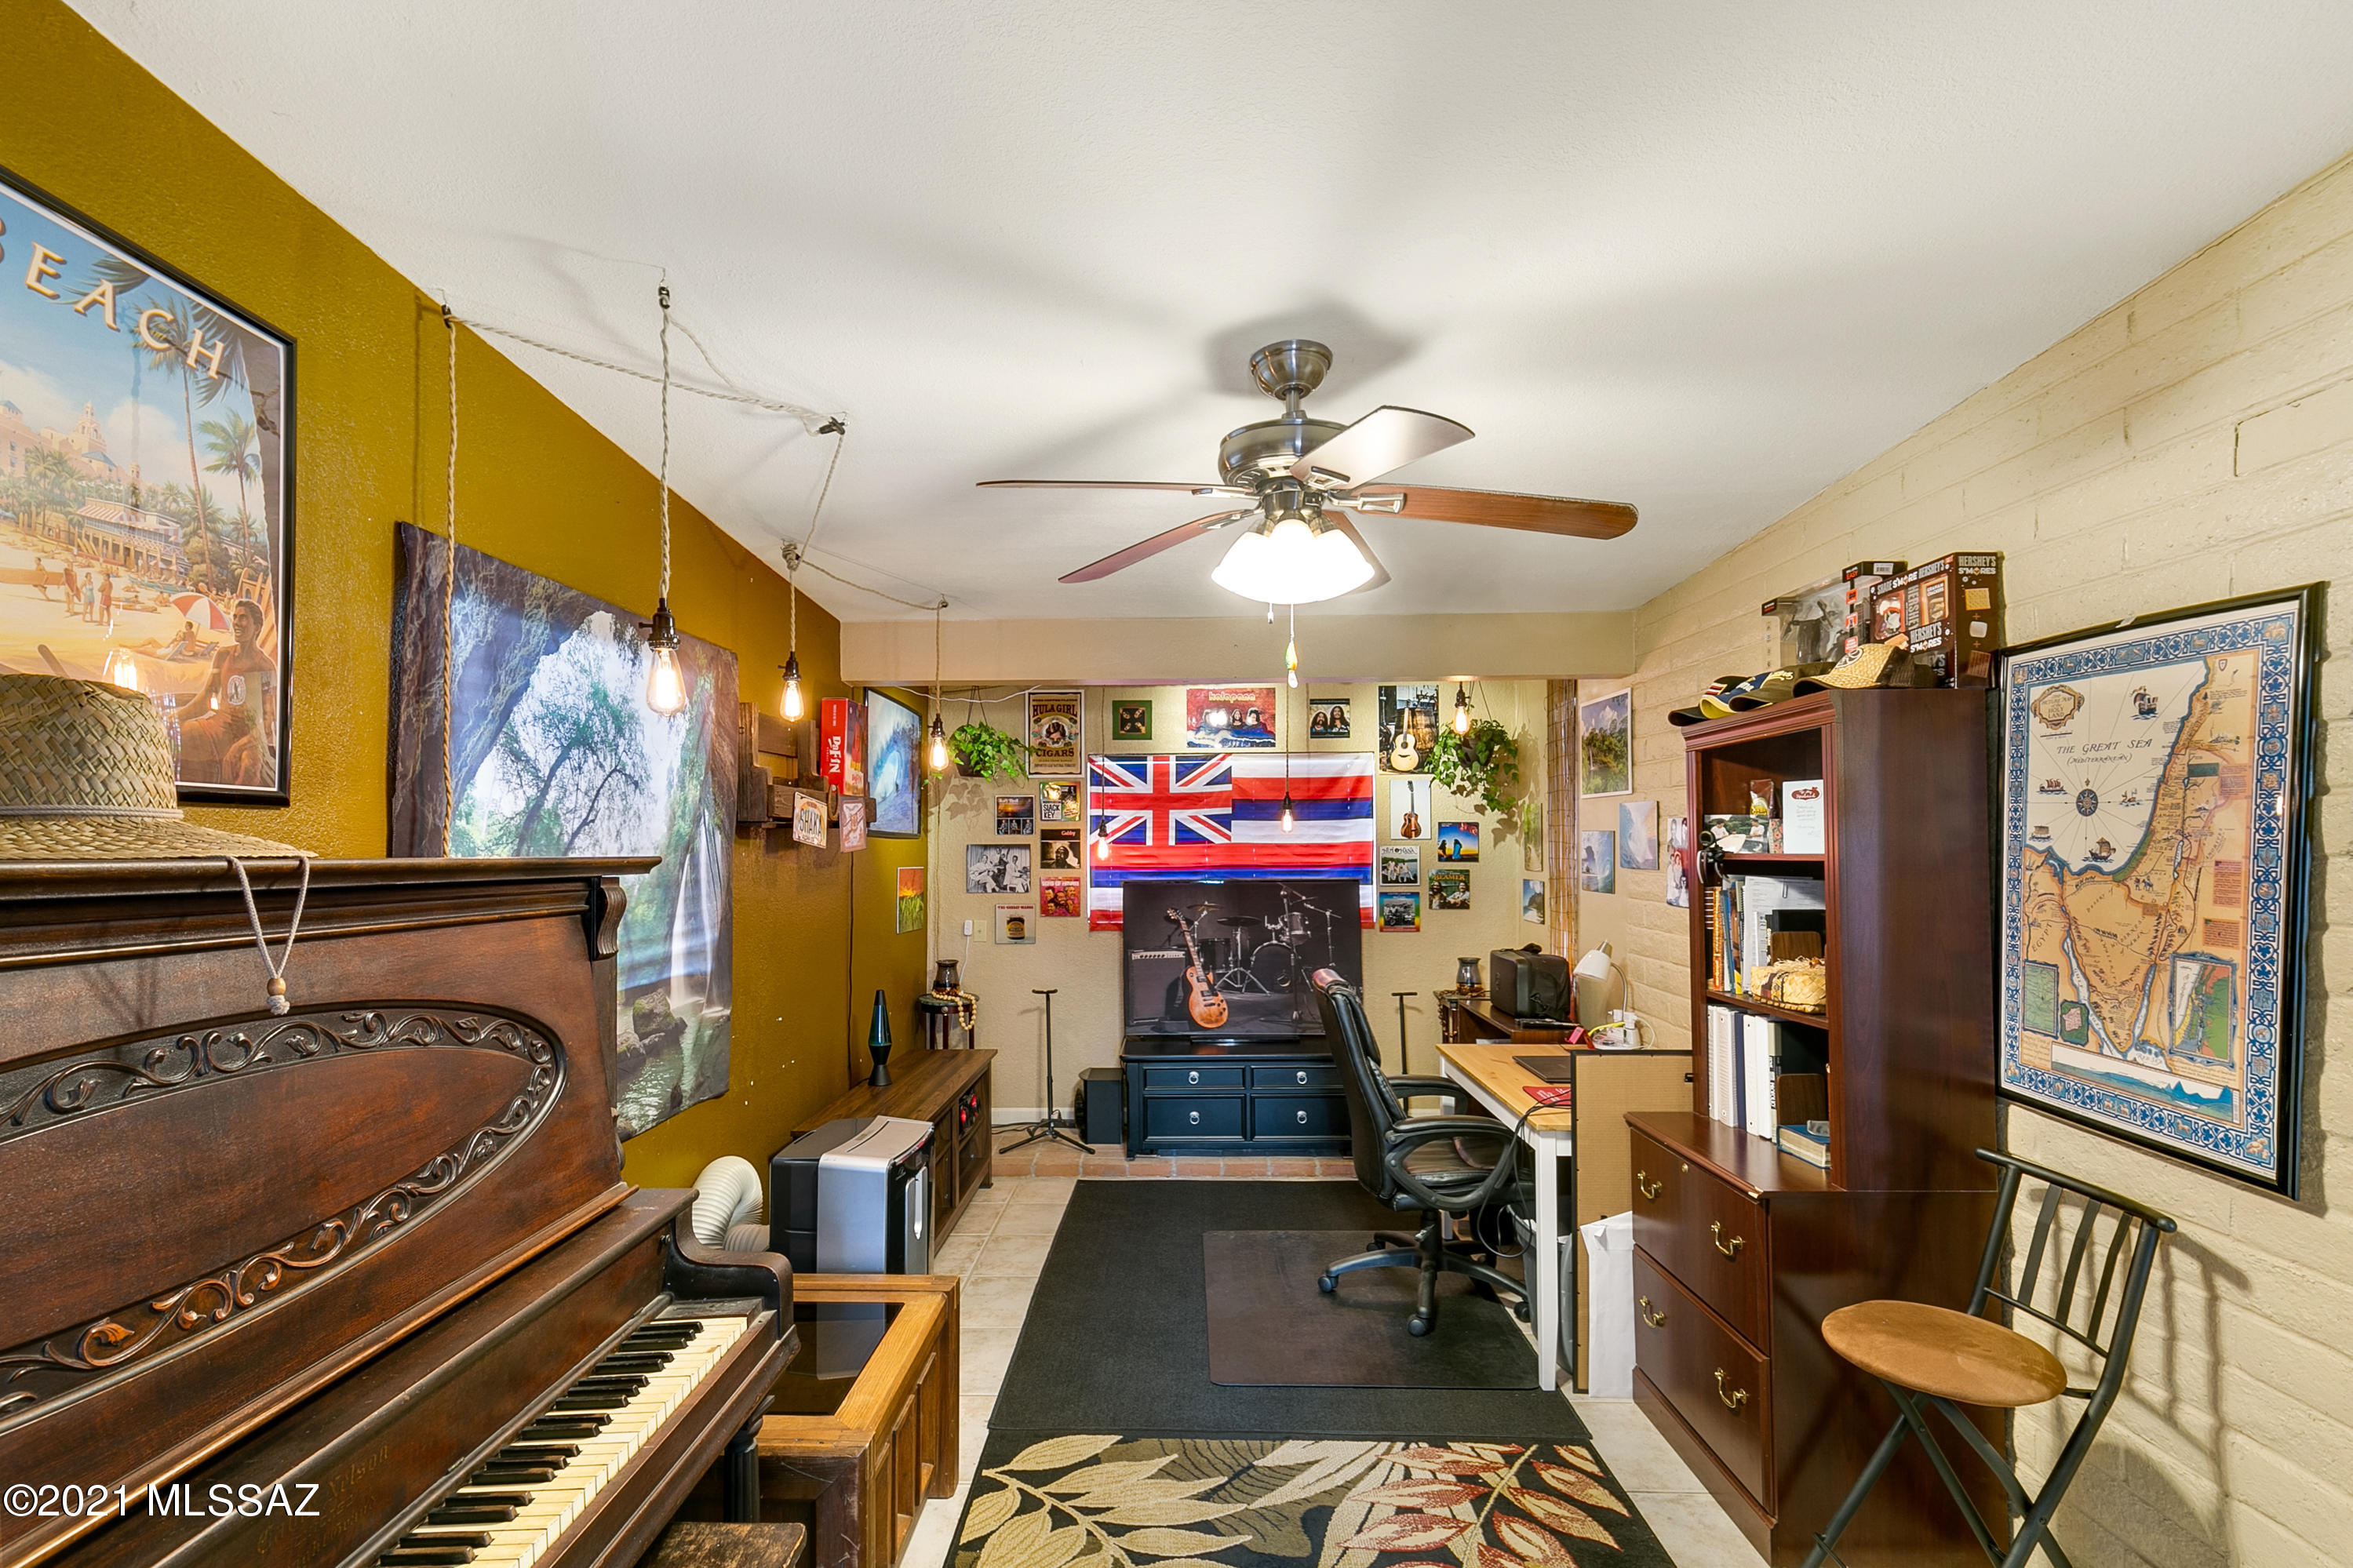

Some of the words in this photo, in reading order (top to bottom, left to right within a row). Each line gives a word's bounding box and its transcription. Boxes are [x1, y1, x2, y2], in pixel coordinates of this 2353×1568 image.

[0, 217, 224, 379] EACH
[1918, 559, 1944, 580] HERSHEY'S
[1958, 555, 1996, 567] HERSHEY'S
[1910, 622, 1942, 644] HERSHEY'S
[1033, 704, 1055, 718] HULA
[1056, 704, 1077, 717] GIRL
[1036, 748, 1074, 757] CIGARS
[2056, 744, 2076, 755] THE
[2082, 740, 2122, 755] GREAT
[2127, 738, 2153, 749] SEA
